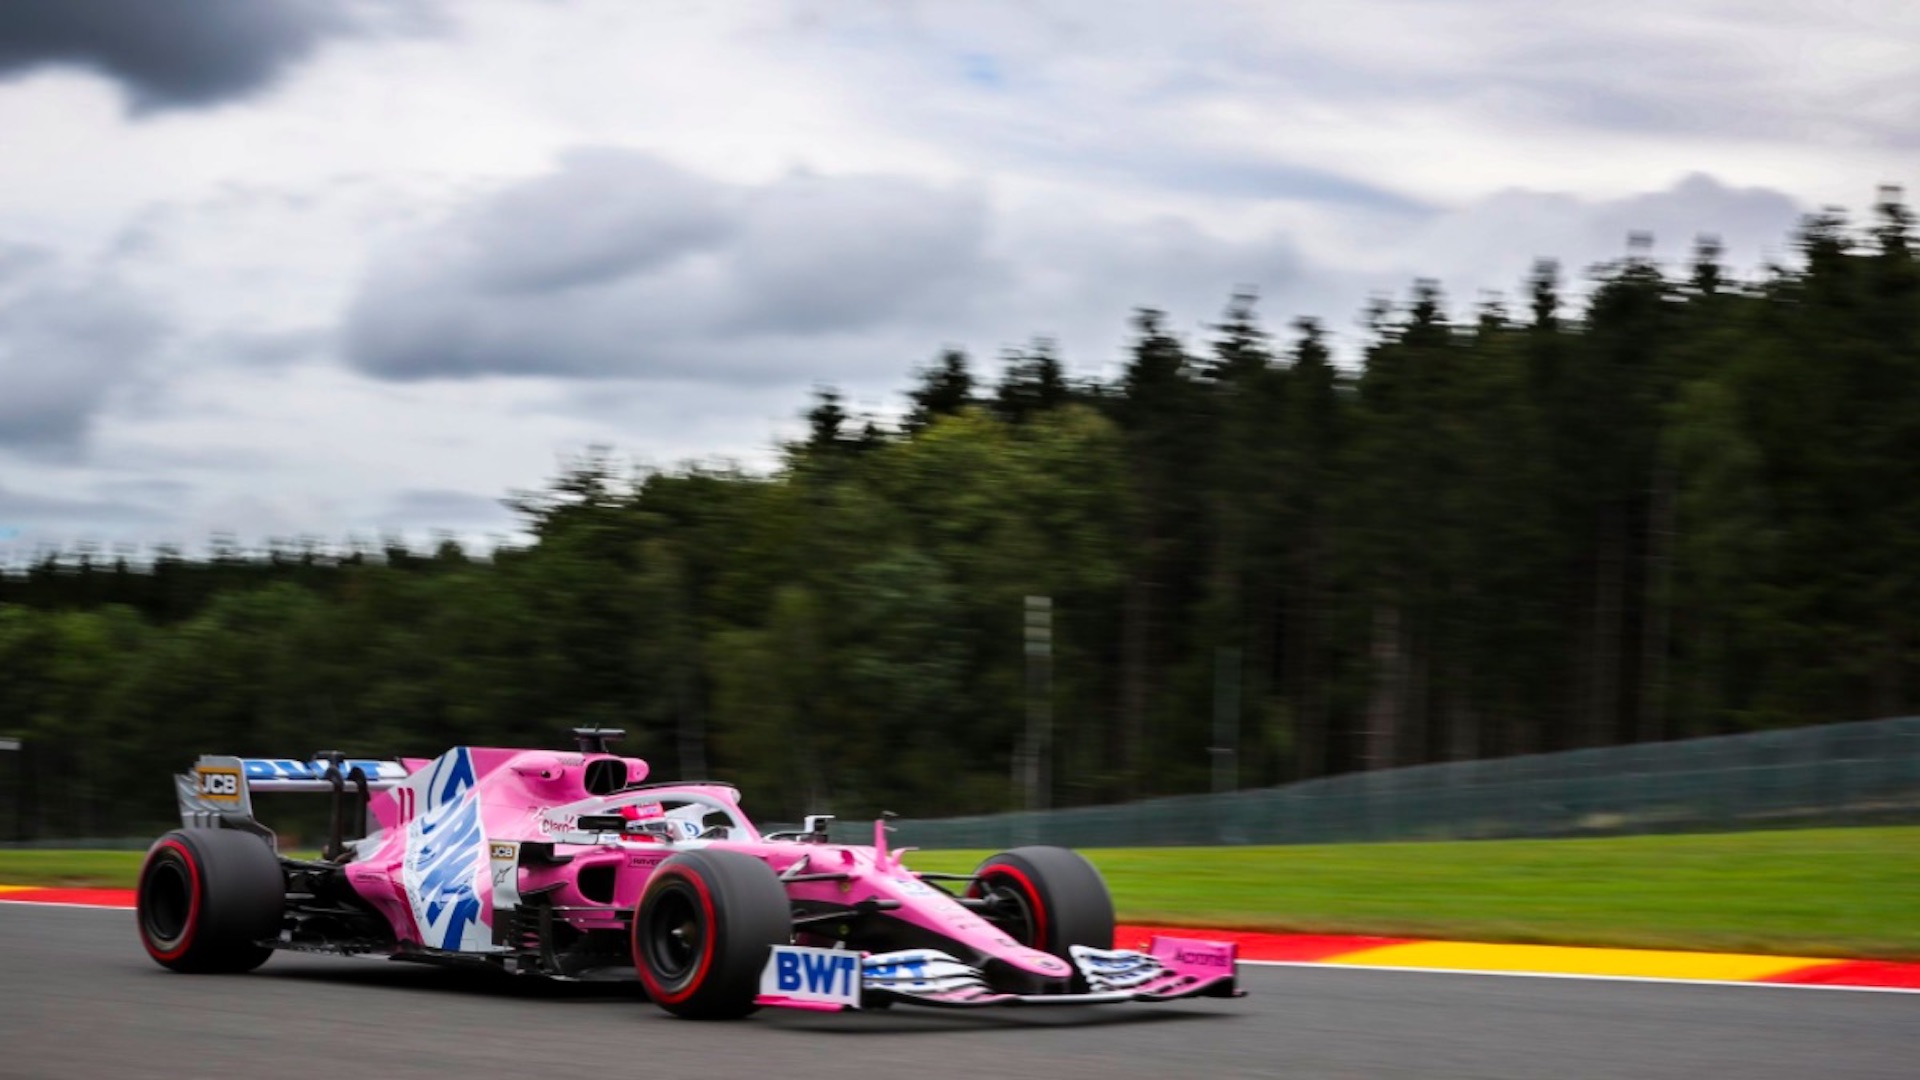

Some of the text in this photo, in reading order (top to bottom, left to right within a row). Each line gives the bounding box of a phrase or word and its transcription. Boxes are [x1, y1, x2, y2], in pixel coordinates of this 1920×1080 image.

[202, 773, 237, 794] JCB
[398, 788, 414, 826] 11
[493, 847, 513, 858] JCB
[776, 951, 855, 997] BWT
